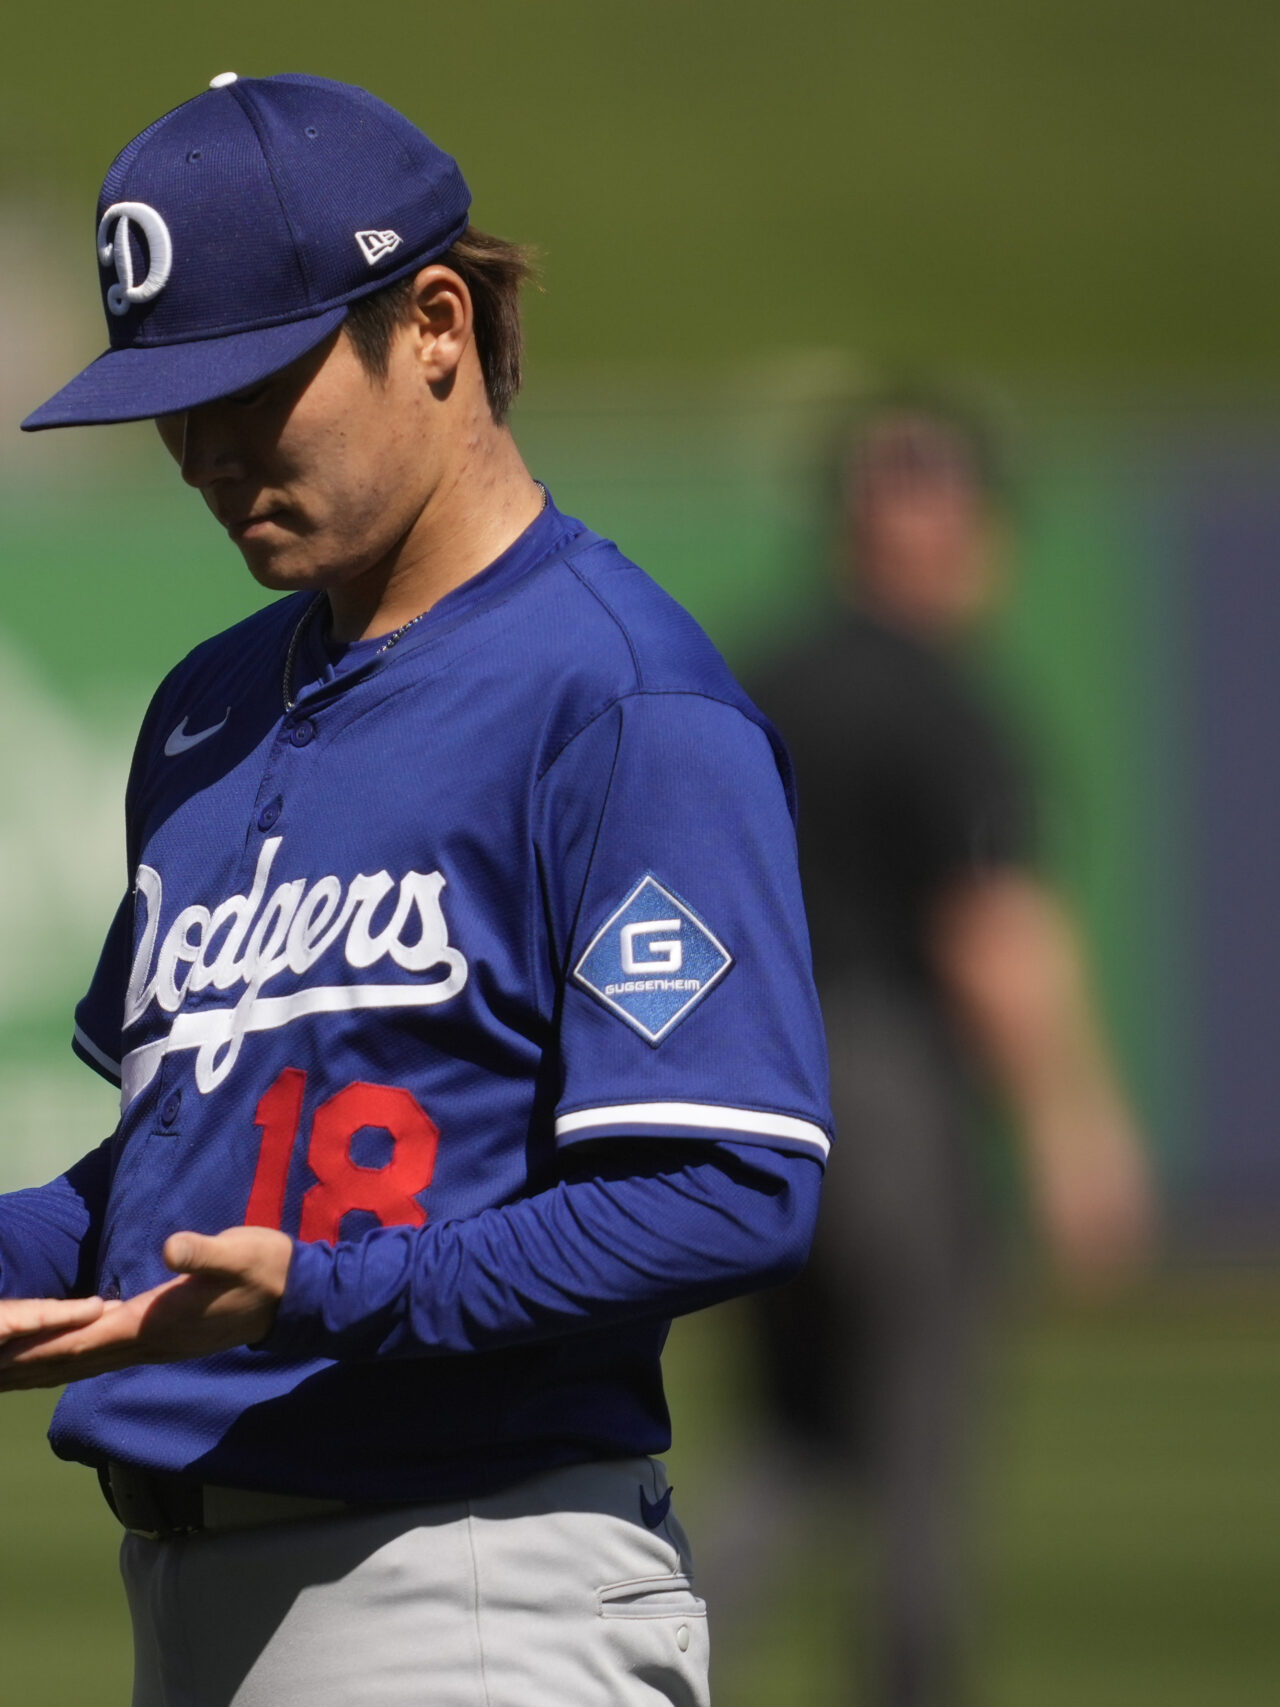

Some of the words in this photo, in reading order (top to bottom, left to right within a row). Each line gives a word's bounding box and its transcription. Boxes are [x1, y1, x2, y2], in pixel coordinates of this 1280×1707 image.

[97, 201, 172, 316] D
[122, 836, 468, 1094] Dodgers
[605, 979, 700, 995] GUGGENHEIM
[620, 918, 682, 975] G
[243, 1066, 440, 1248] 18
